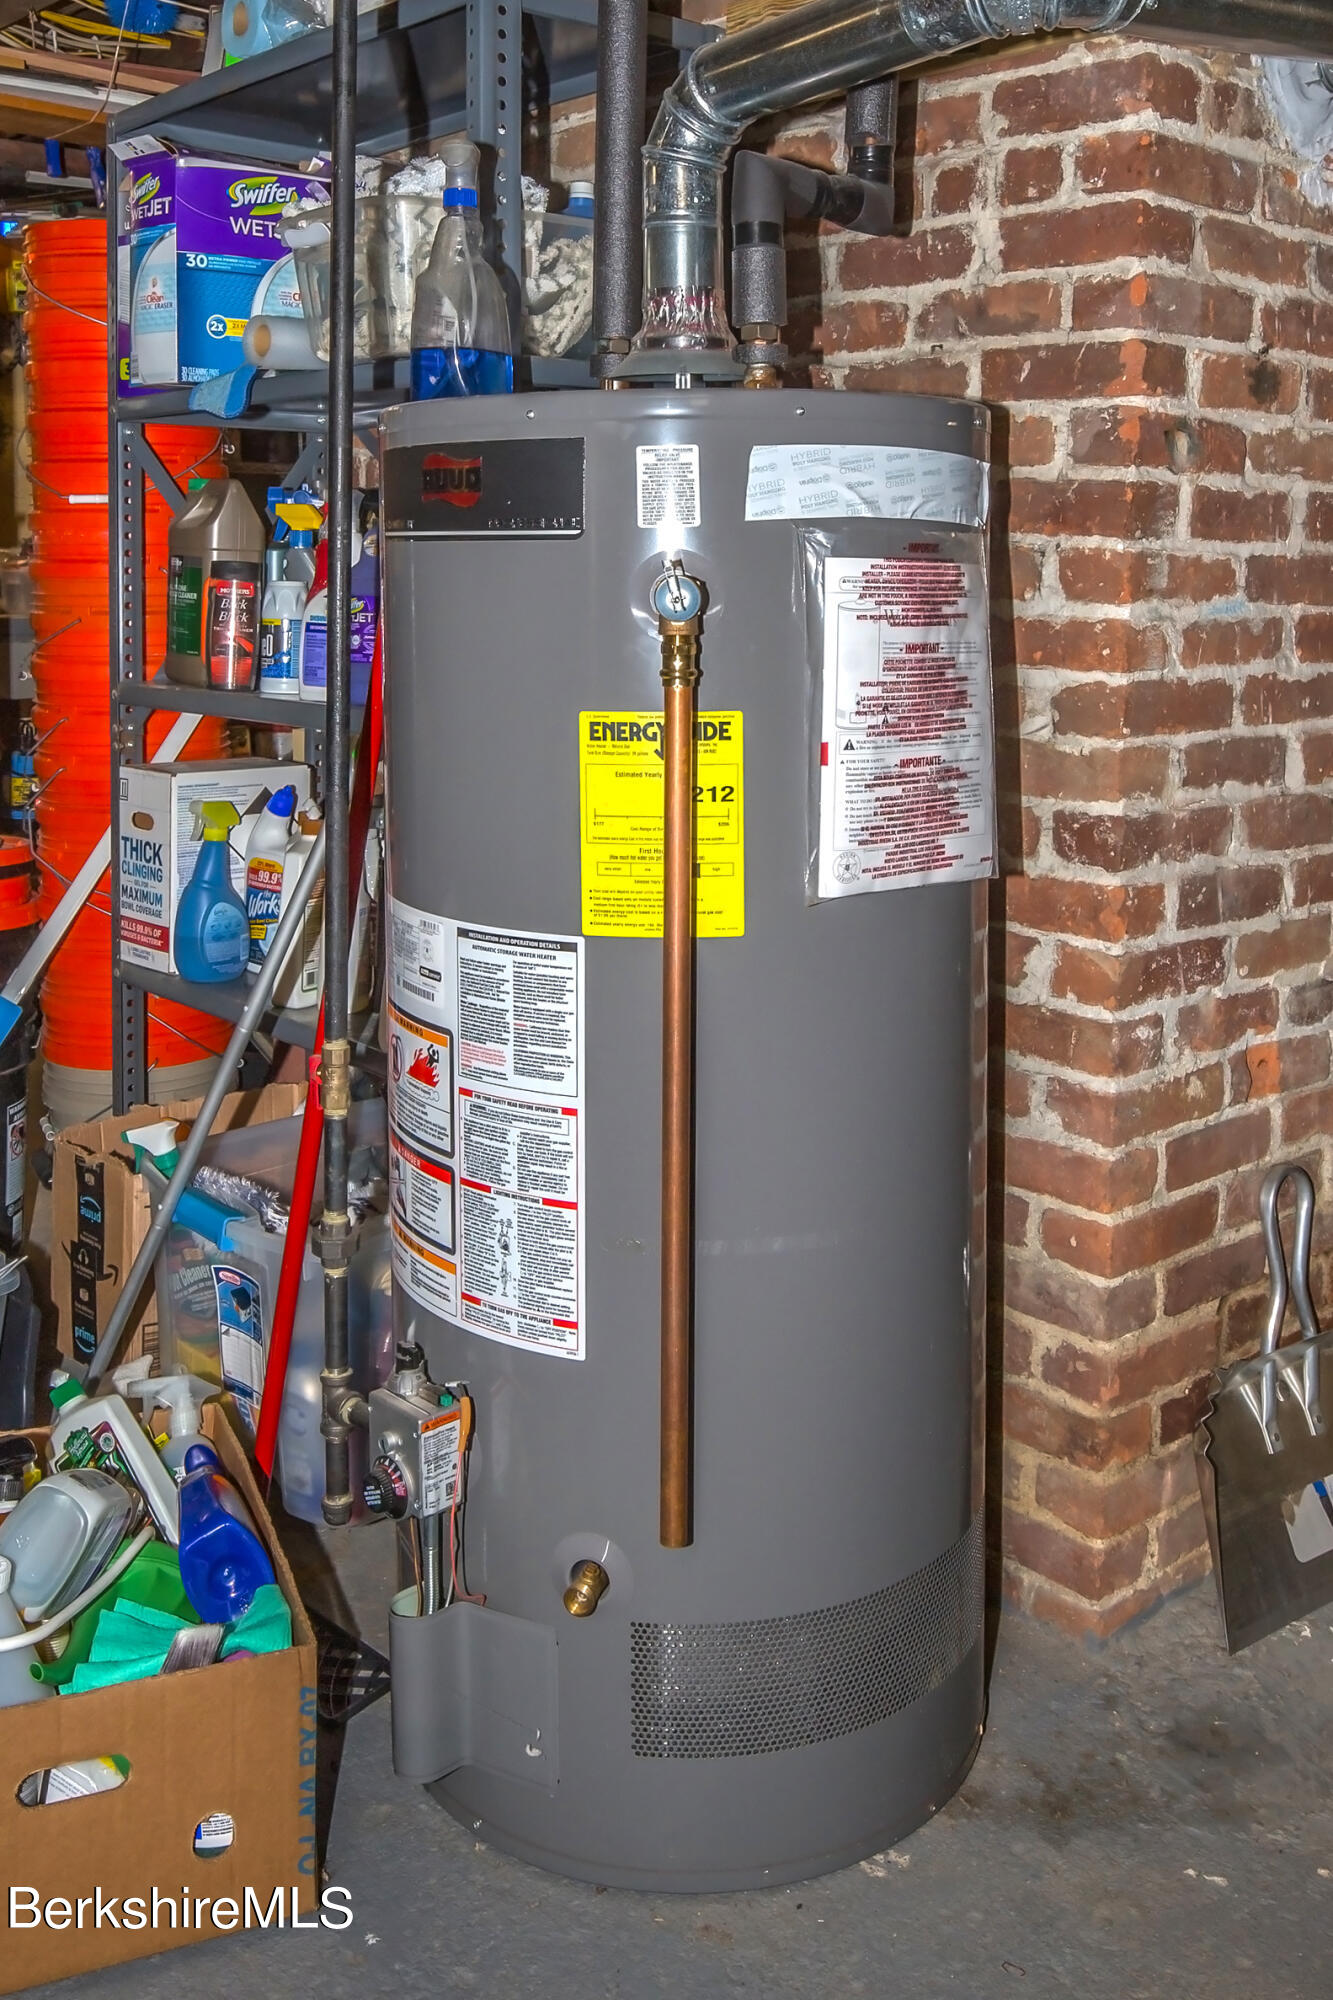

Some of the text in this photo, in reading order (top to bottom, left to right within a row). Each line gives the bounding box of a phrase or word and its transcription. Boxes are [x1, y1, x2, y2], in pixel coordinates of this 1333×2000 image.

[129, 176, 160, 204] Swiffer
[230, 183, 296, 208] Swiffer
[186, 254, 208, 268] 30
[154, 302, 173, 310] ERASER
[210, 321, 224, 332] 2x
[790, 448, 832, 462] HYBRID
[886, 478, 916, 488] HYBRID
[798, 490, 839, 504] HYBRID
[905, 643, 940, 654] IMPORTANT
[900, 756, 941, 768] IMPORTANTE
[121, 836, 163, 866] THICK
[121, 860, 163, 883] CLINGING
[121, 884, 163, 908] MAXIMUM
[121, 900, 162, 919] BOWL COVERAGE
[121, 920, 136, 932] KILLS
[153, 928, 162, 938] OF
[468, 932, 499, 942] INSTALLATION
[510, 938, 538, 947] OPERATION
[472, 944, 496, 954] AUTOMATIC
[497, 949, 518, 957] STORAGE
[400, 1017, 424, 1036] WARNING
[492, 1097, 506, 1106] SAFETY
[518, 1103, 533, 1111] BEFORE
[534, 1106, 558, 1114] OPERATING
[494, 1189, 540, 1204] LIGHTING INSTRUCTIONS
[80, 1207, 101, 1223] prime
[180, 1265, 211, 1286] Cleaner
[529, 1316, 551, 1325] APPLIANCE
[75, 1327, 95, 1344] prime
